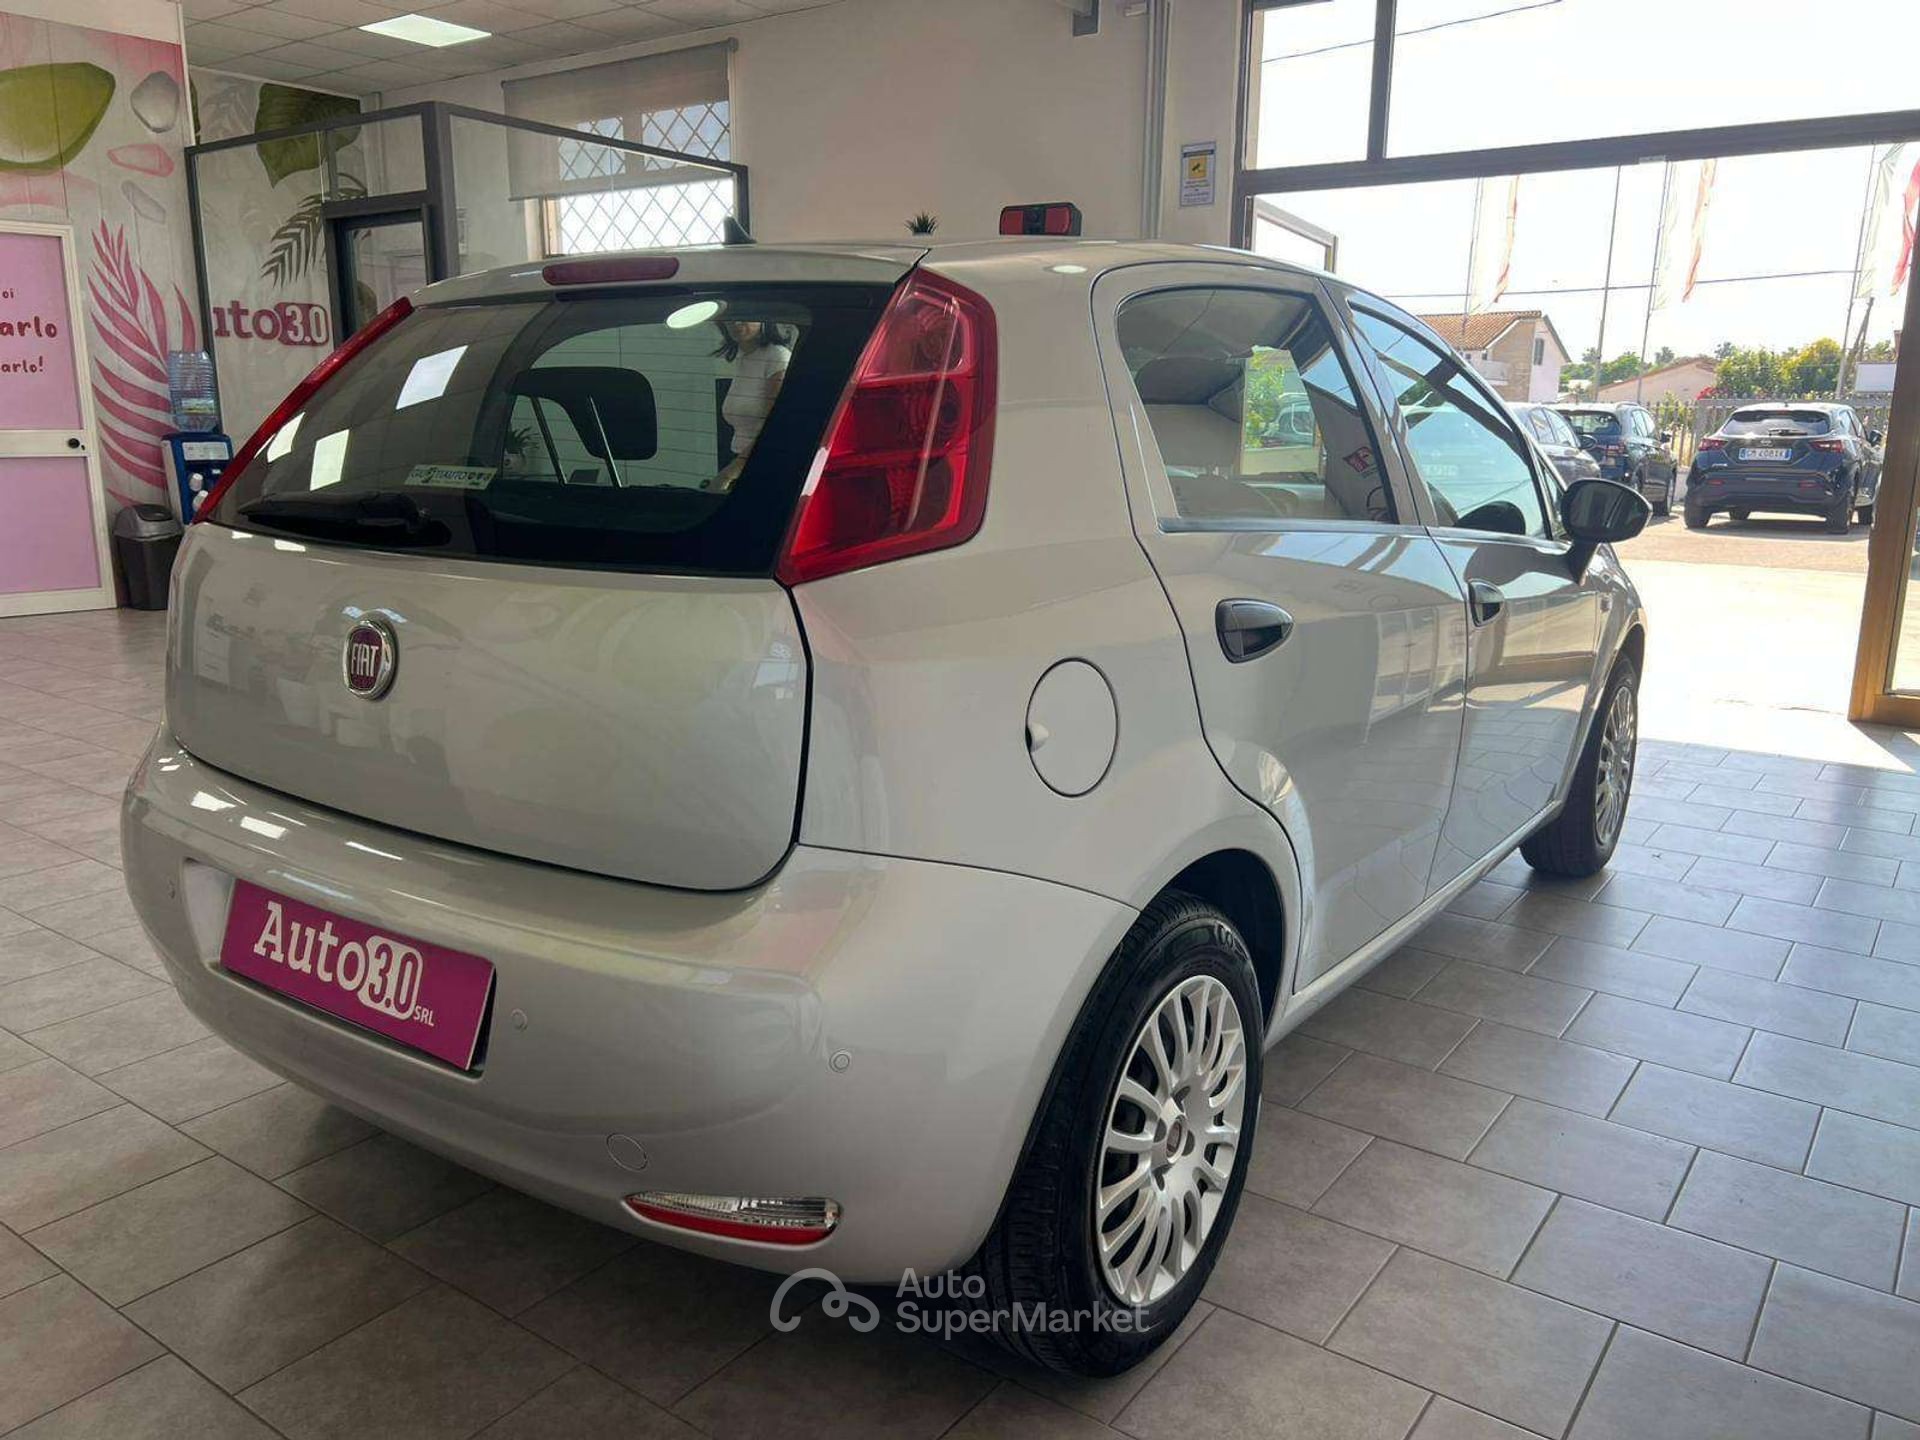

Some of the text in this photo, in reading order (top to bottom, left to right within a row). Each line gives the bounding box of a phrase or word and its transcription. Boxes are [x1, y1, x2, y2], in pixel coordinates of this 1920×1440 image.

[2, 287, 14, 299] oi
[0, 315, 57, 338] arlo
[0, 355, 43, 373] arlo!
[351, 643, 380, 677] FIAT
[412, 1004, 435, 1027] SRL
